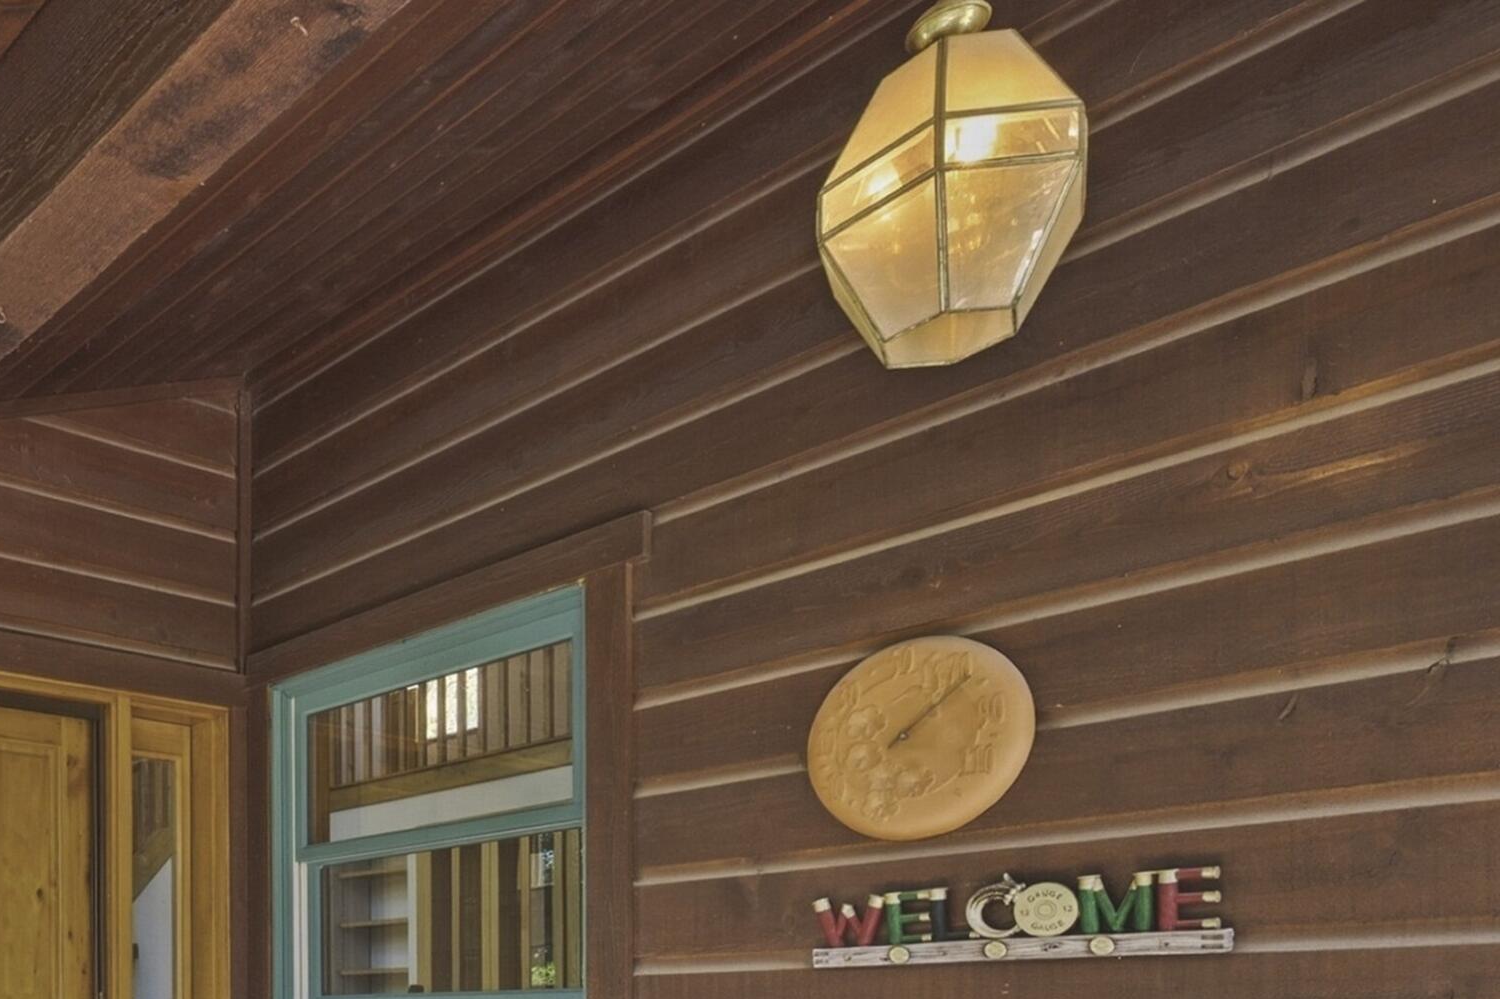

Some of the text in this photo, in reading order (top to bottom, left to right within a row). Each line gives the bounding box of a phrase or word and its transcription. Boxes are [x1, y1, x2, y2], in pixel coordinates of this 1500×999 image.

[1026, 889, 1063, 903] GAUGE
[813, 866, 1221, 948] WELCOME
[1030, 920, 1065, 932] GAUGE
